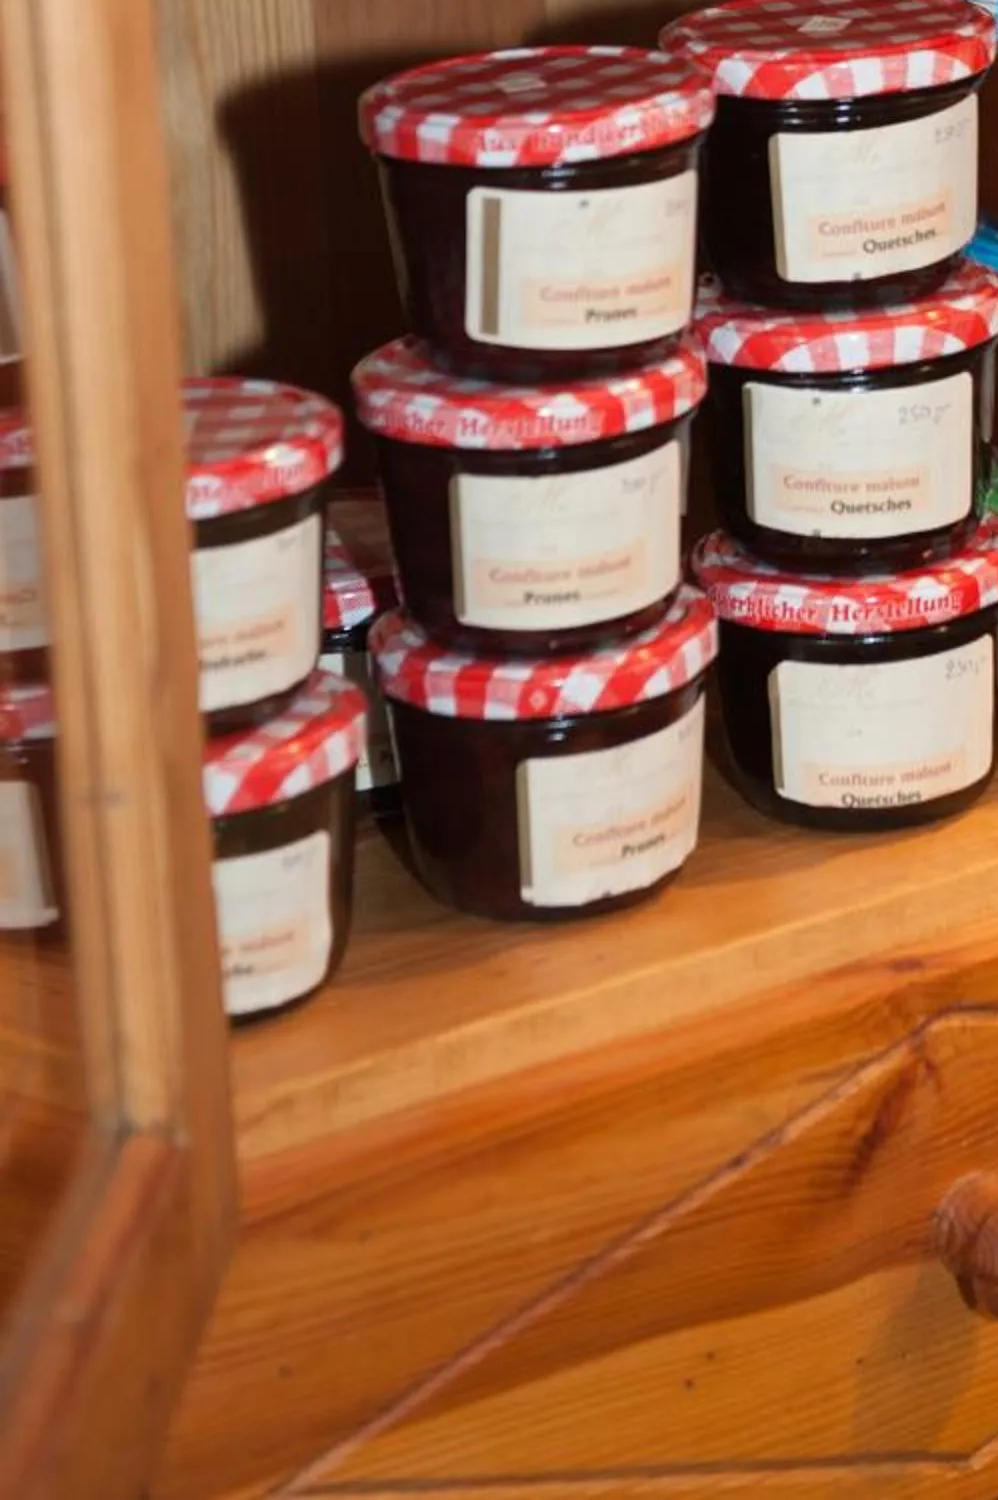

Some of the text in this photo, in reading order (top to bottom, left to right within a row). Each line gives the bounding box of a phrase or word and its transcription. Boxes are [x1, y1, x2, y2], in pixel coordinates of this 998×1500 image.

[817, 216, 897, 238] Confiture
[783, 473, 860, 492] Confiture
[829, 498, 913, 517] Quetsches
